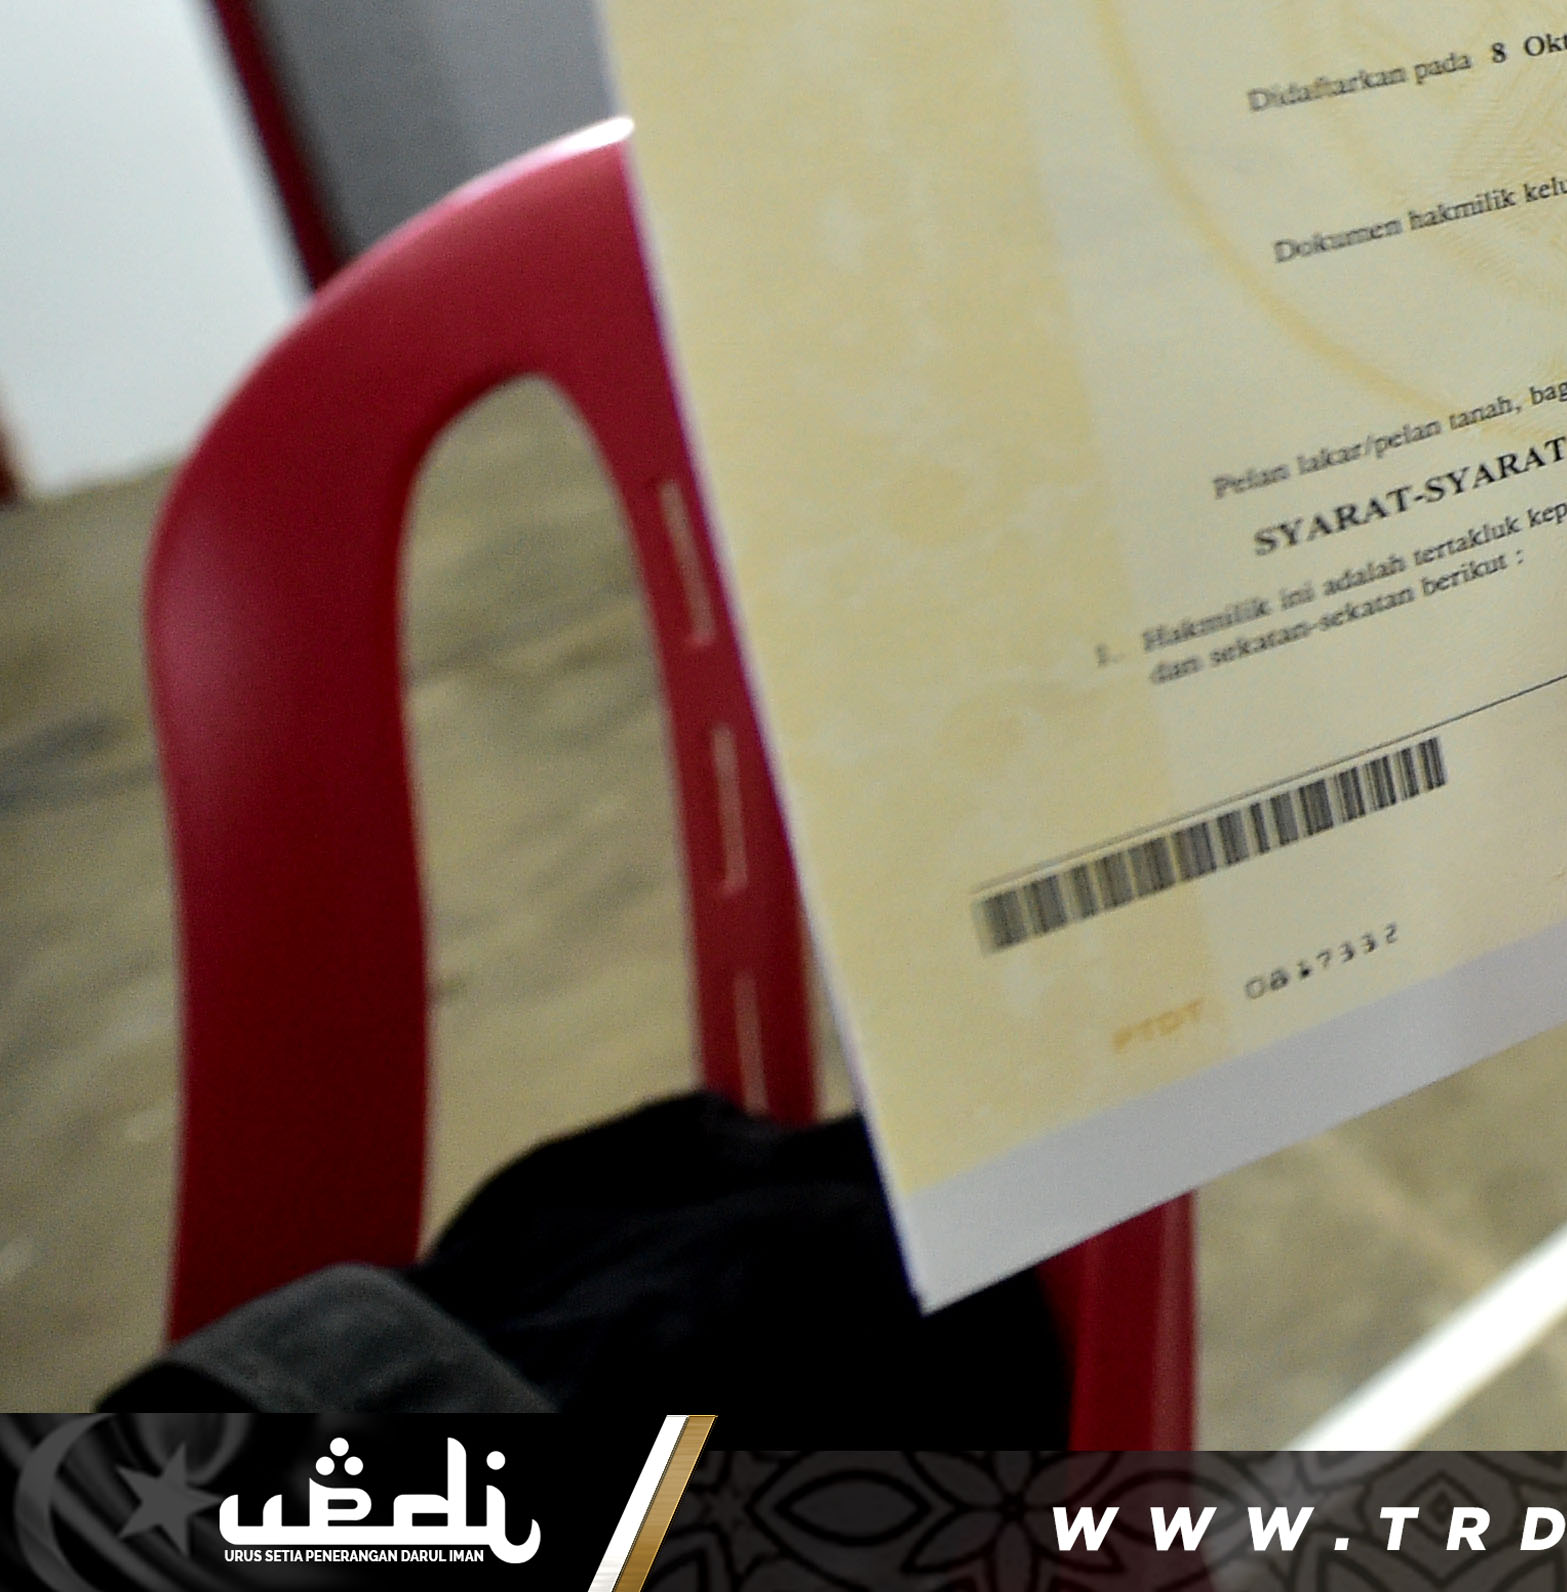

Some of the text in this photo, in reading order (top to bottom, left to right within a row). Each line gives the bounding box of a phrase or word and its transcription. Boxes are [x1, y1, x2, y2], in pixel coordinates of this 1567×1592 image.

[1246, 62, 1408, 113] Didaftarkan
[1412, 49, 1473, 85] pada
[1491, 41, 1508, 65] 8
[1273, 215, 1403, 264] Dokumen
[1408, 185, 1518, 232] hakmilik
[1213, 460, 1290, 500] Pelan
[1296, 417, 1442, 476] lakar/pelan
[1449, 396, 1523, 434] tanah,
[1141, 595, 1272, 654] Hakmilik
[1280, 580, 1315, 612] ini
[1322, 553, 1407, 599] adalah
[1413, 514, 1522, 569] tertakluk
[1149, 555, 1508, 685] dan sekatan-sekatan berikut
